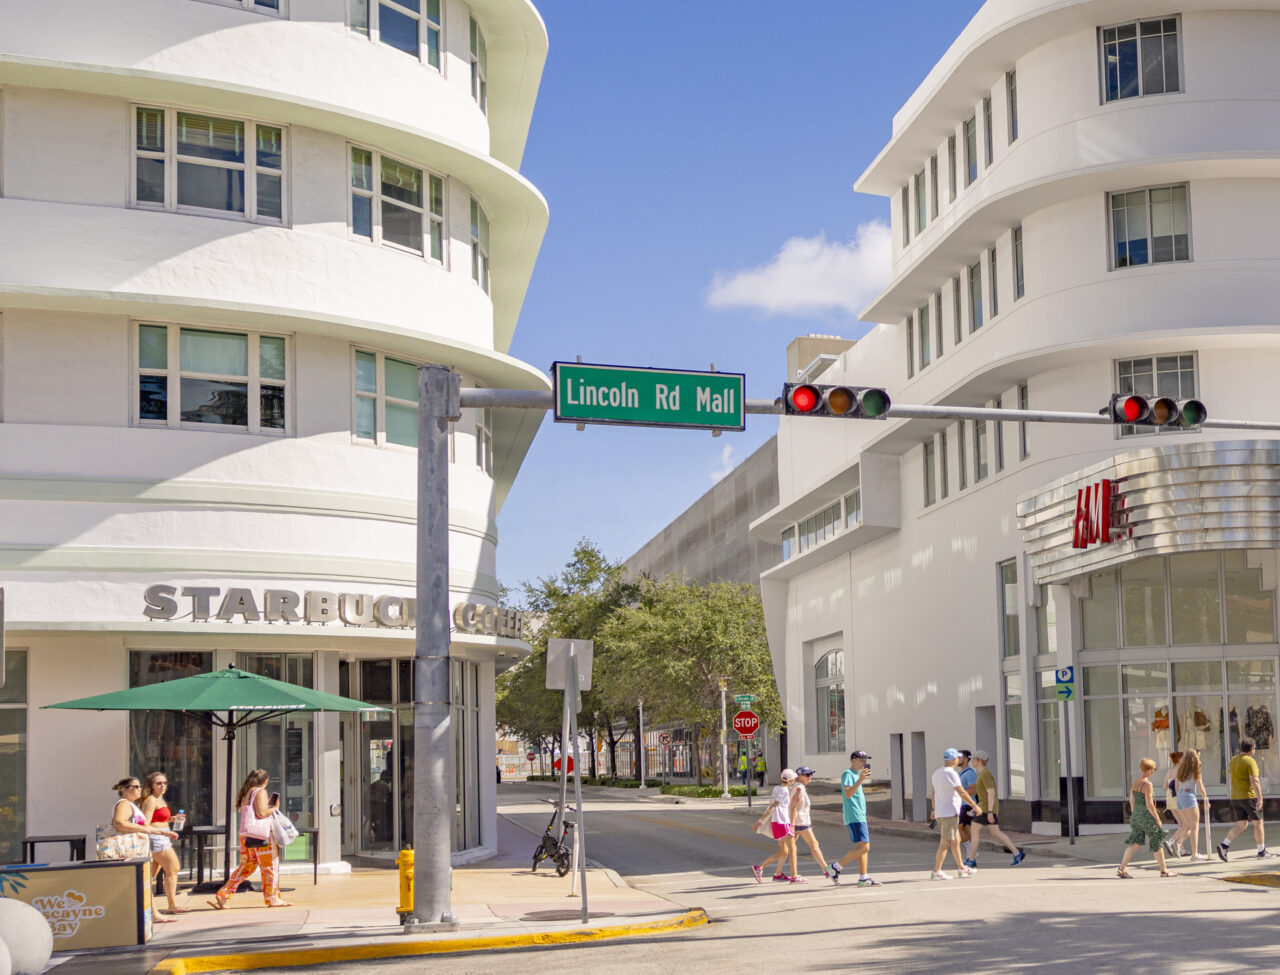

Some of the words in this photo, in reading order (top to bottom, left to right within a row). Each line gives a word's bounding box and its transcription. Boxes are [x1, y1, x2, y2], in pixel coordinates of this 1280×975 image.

[567, 378, 639, 408] Lincoln
[655, 384, 680, 411] Rd
[697, 386, 735, 414] Mall
[143, 584, 417, 627] STARBUC
[735, 717, 758, 728] STOP
[35, 897, 65, 909] We
[38, 907, 103, 921] scayne
